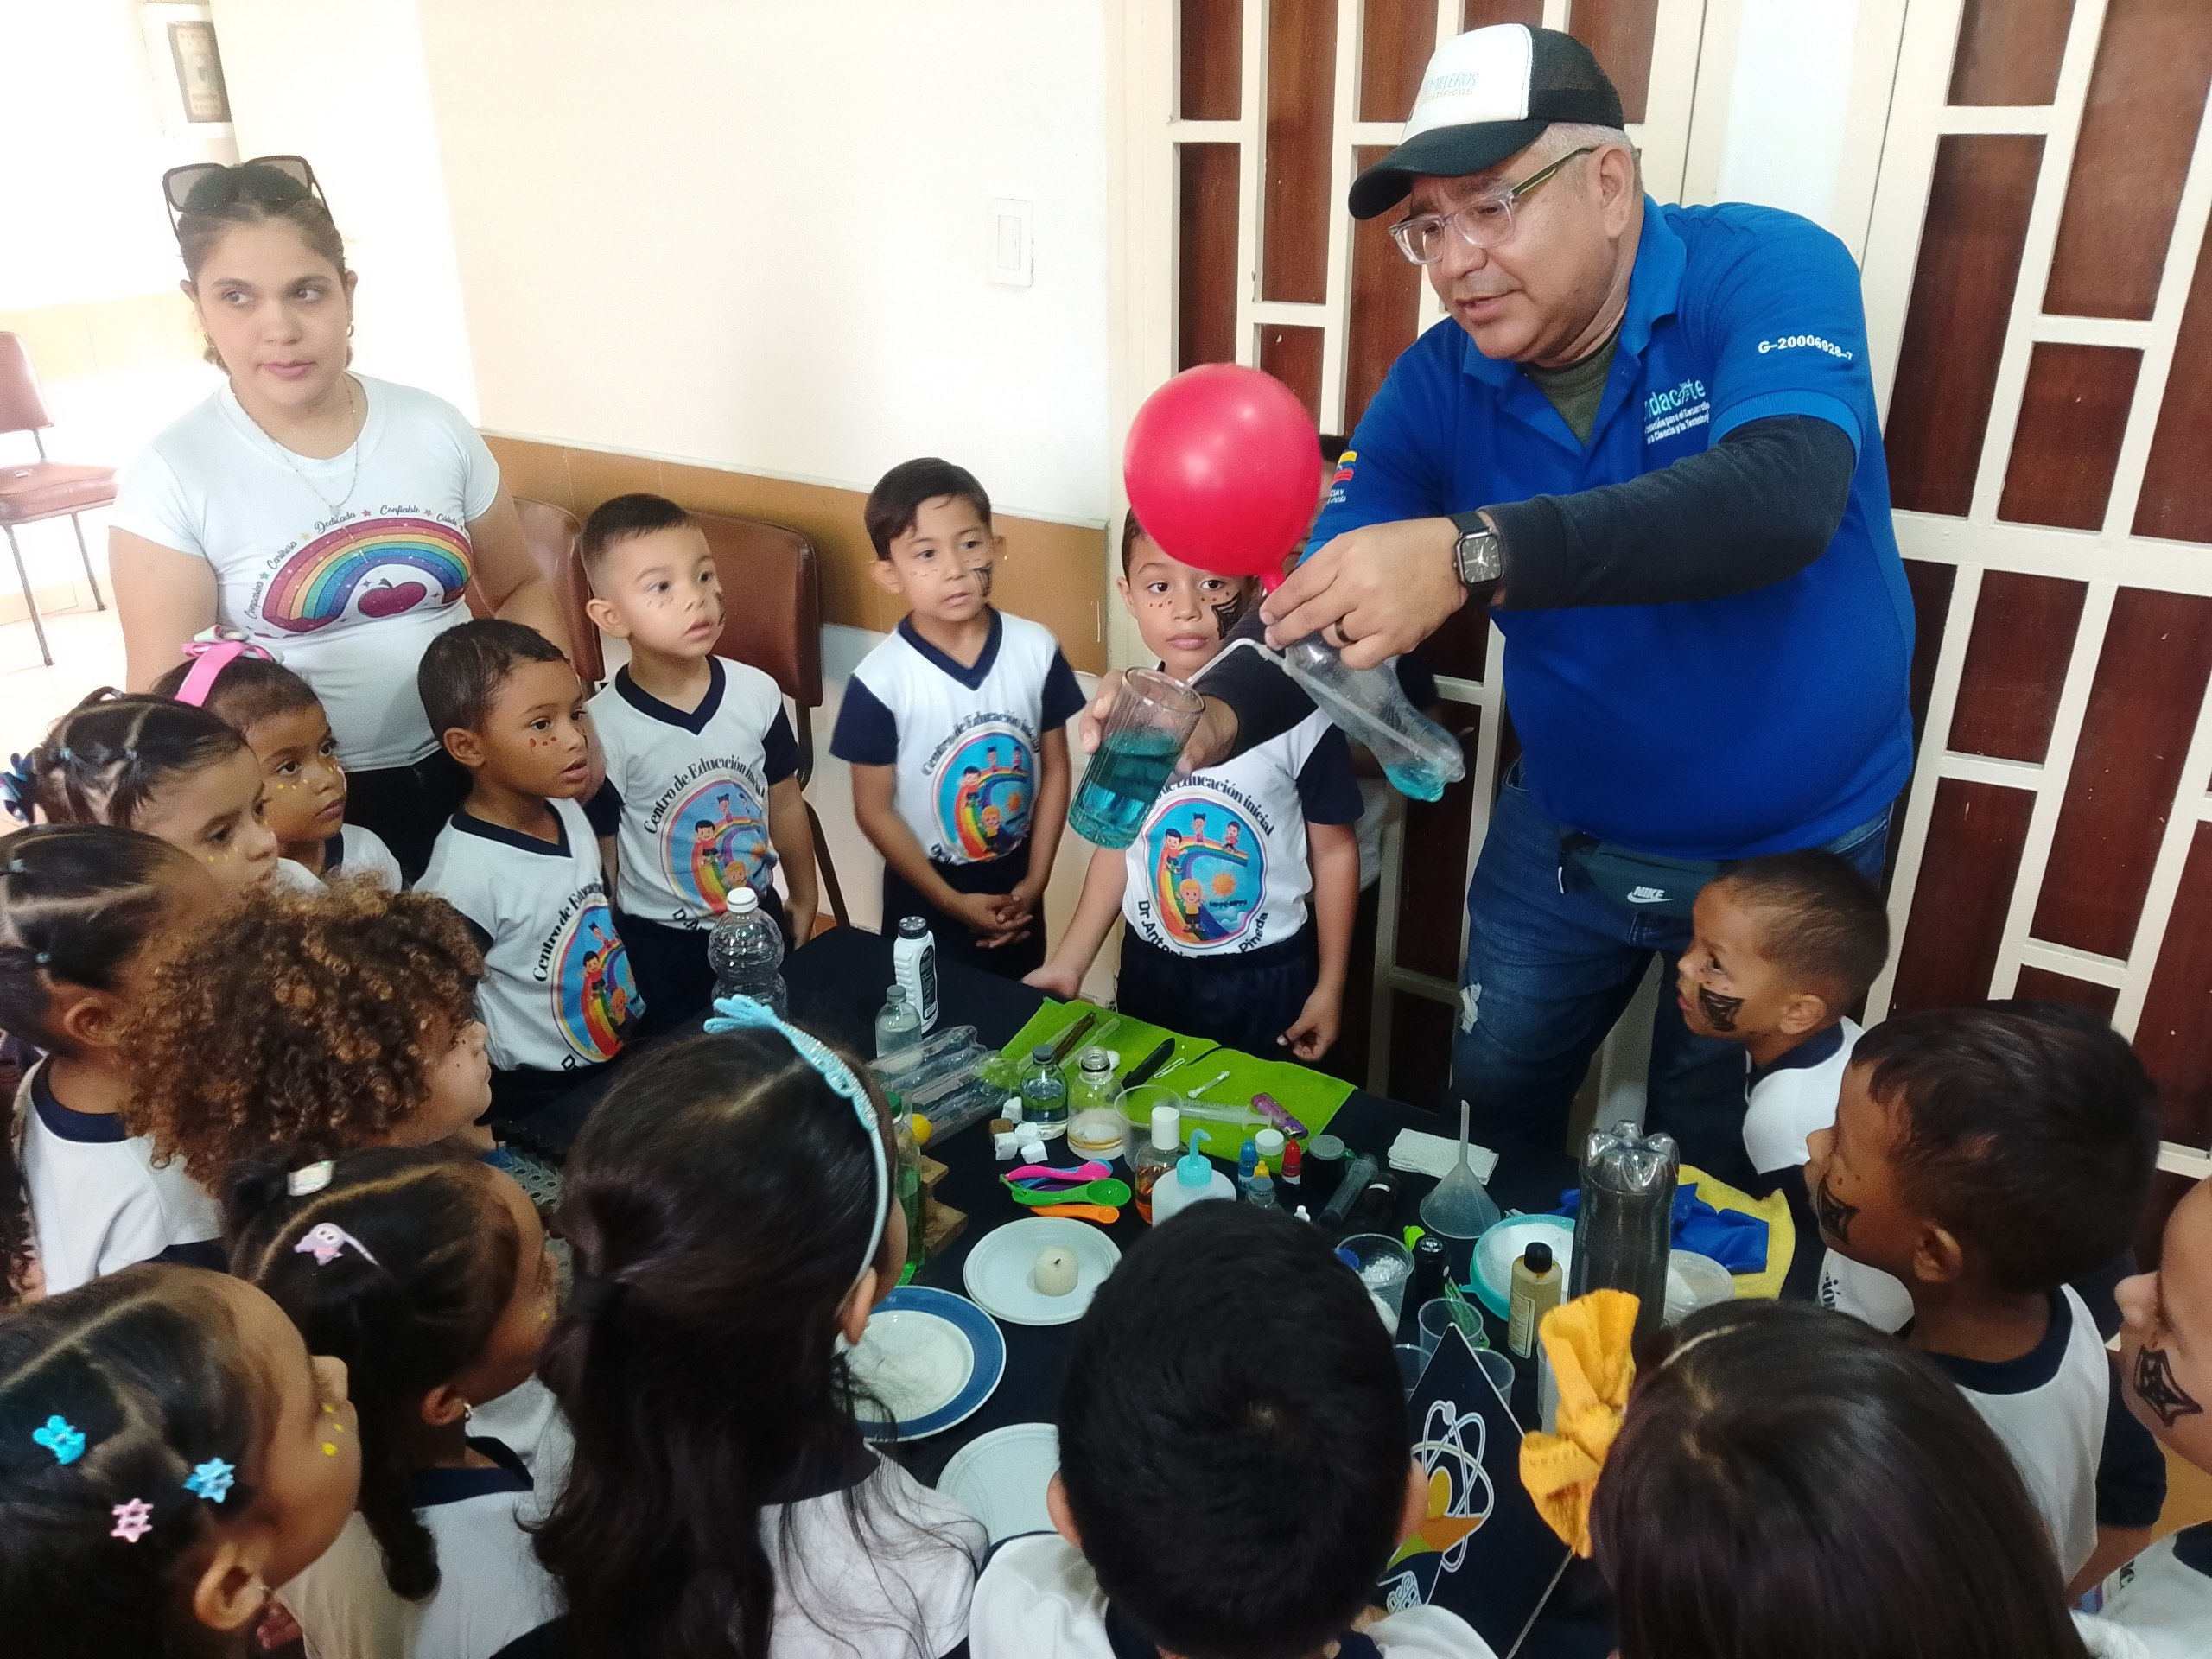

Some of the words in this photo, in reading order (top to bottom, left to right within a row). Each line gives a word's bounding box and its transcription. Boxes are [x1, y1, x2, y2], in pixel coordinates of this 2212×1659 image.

[1758, 334, 1853, 361] G-20006928-7
[379, 505, 421, 516] Confiable
[644, 787, 677, 834] Centro
[673, 774, 692, 792] de
[1243, 794, 1275, 838] inicial
[1632, 885, 1666, 899] NIKE
[532, 925, 562, 982] Centro
[558, 906, 574, 926] de
[1238, 912, 1269, 952] Pineda
